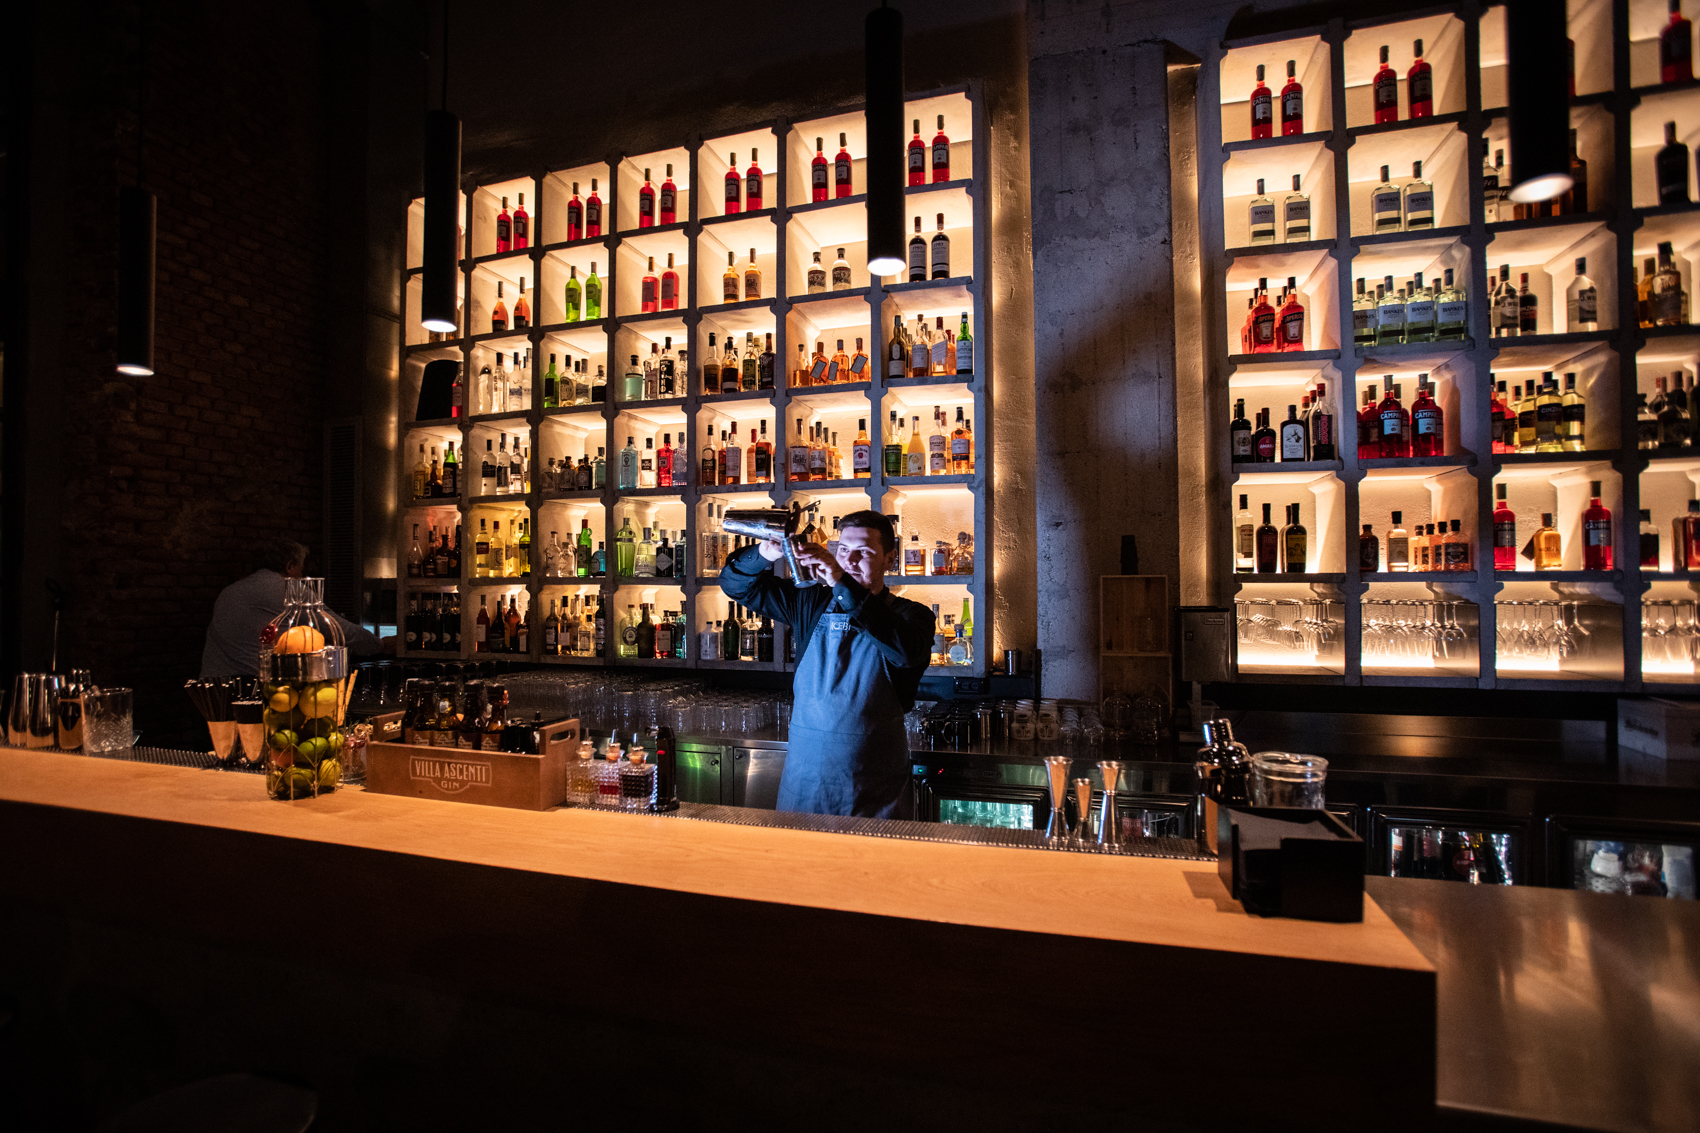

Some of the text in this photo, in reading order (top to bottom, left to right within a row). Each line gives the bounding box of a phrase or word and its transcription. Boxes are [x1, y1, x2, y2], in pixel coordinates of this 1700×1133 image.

[1494, 523, 1515, 531] CAMPA
[1585, 520, 1611, 530] CAMPA
[415, 760, 486, 782] VILLA ASCENTI
[441, 780, 460, 789] GIN
